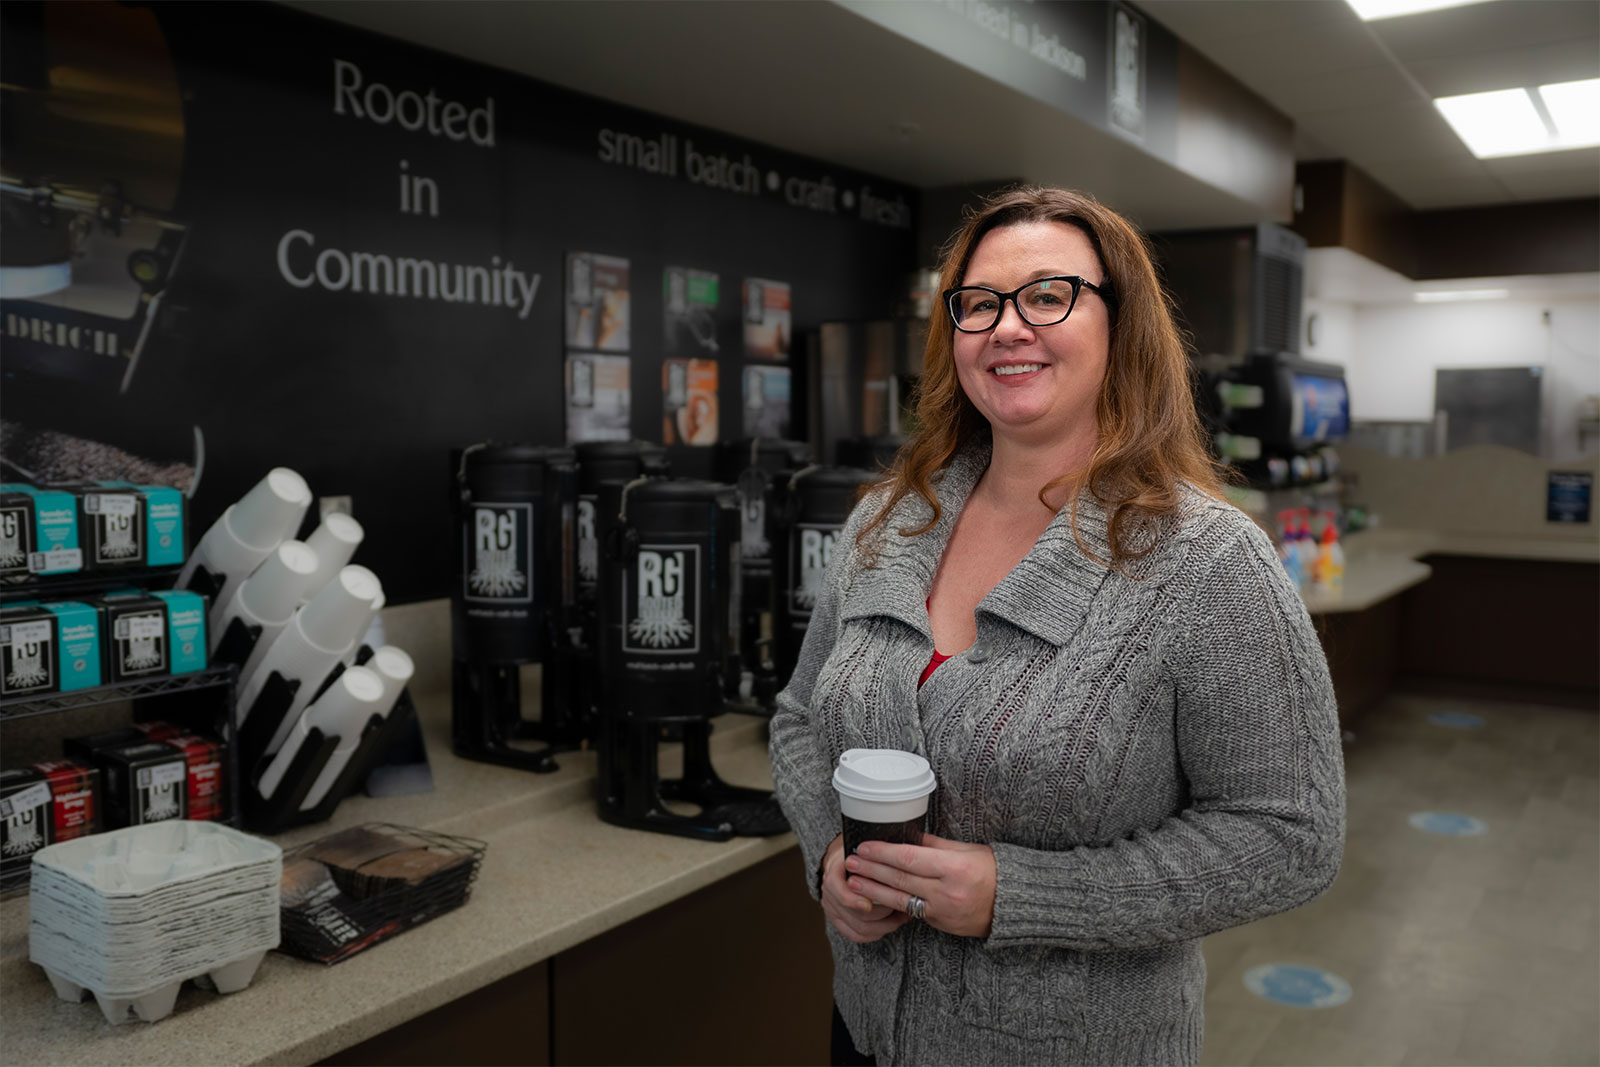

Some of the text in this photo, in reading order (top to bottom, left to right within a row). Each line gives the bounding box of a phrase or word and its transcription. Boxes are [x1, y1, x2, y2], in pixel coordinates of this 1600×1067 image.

[333, 58, 496, 148] Rooted
[399, 159, 440, 218] in
[597, 126, 912, 232] small batch craft fresh
[276, 229, 542, 320] Community
[0, 311, 119, 358] DRICH
[475, 508, 518, 551] RG
[638, 551, 685, 598] RG
